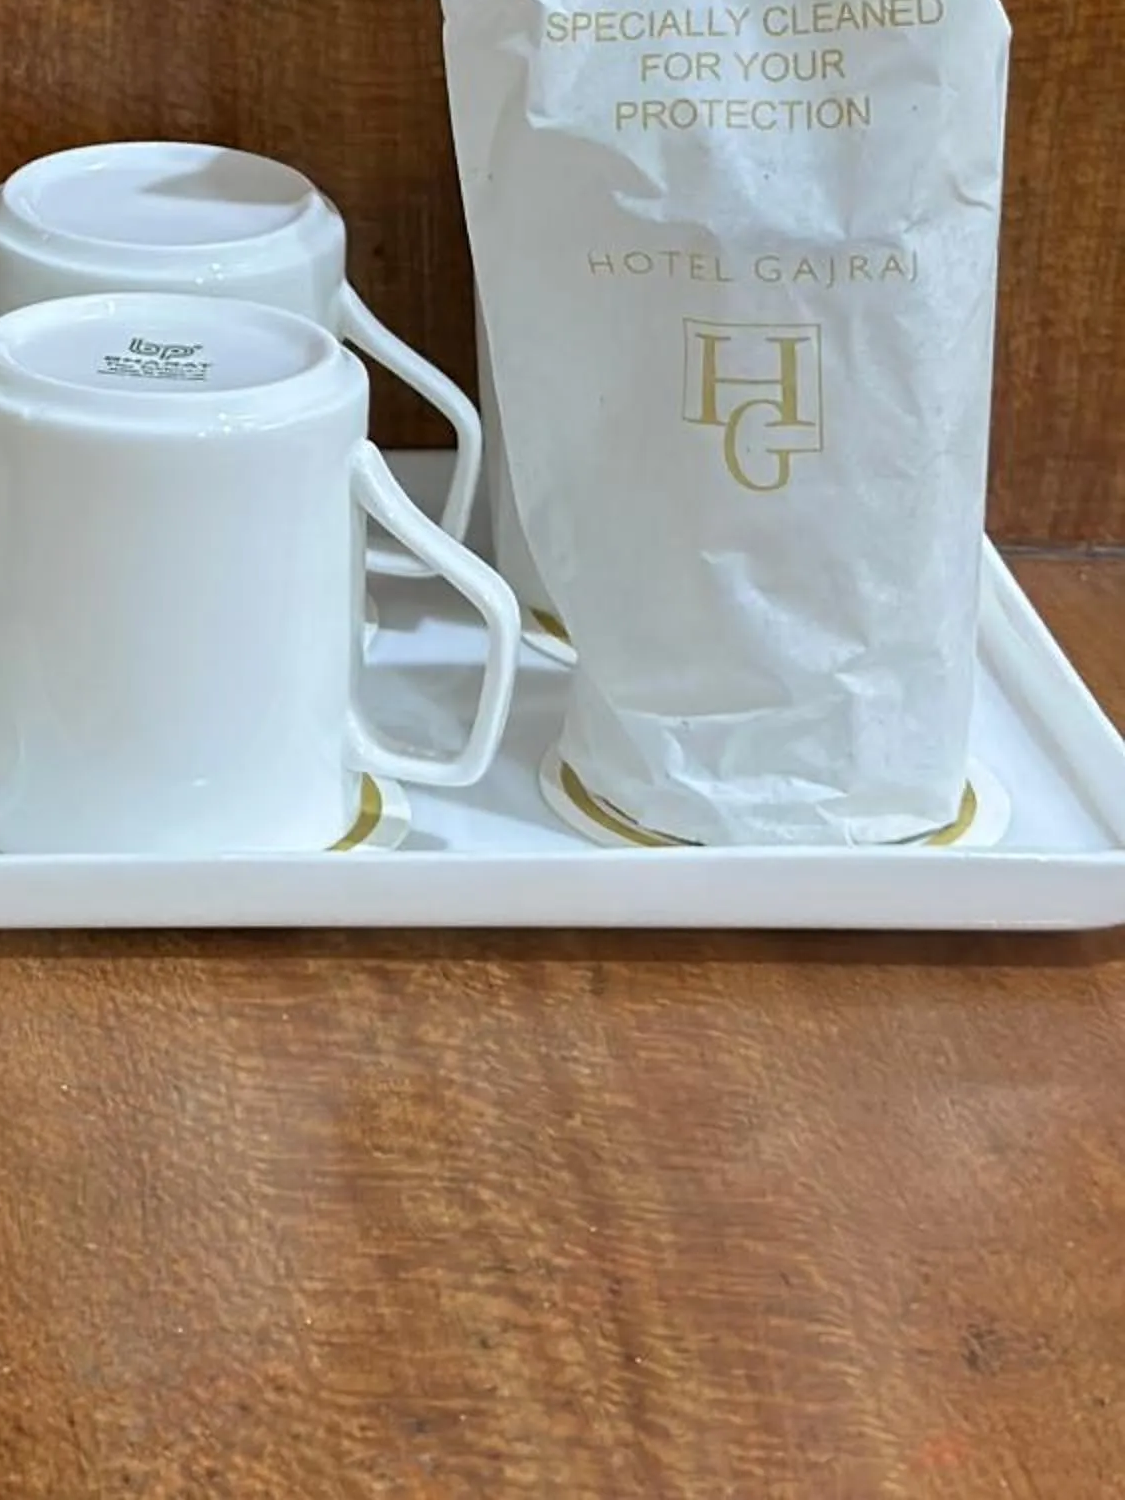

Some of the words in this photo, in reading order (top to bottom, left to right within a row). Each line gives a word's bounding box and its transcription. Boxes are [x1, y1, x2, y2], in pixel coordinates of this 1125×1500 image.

[546, 6, 750, 42] SPECIALLY
[640, 52, 722, 83] FOR
[733, 49, 846, 82] YOUR
[614, 96, 871, 131] PROTECTION
[588, 250, 731, 283] HOTEL
[754, 251, 920, 289] GAJRAJ
